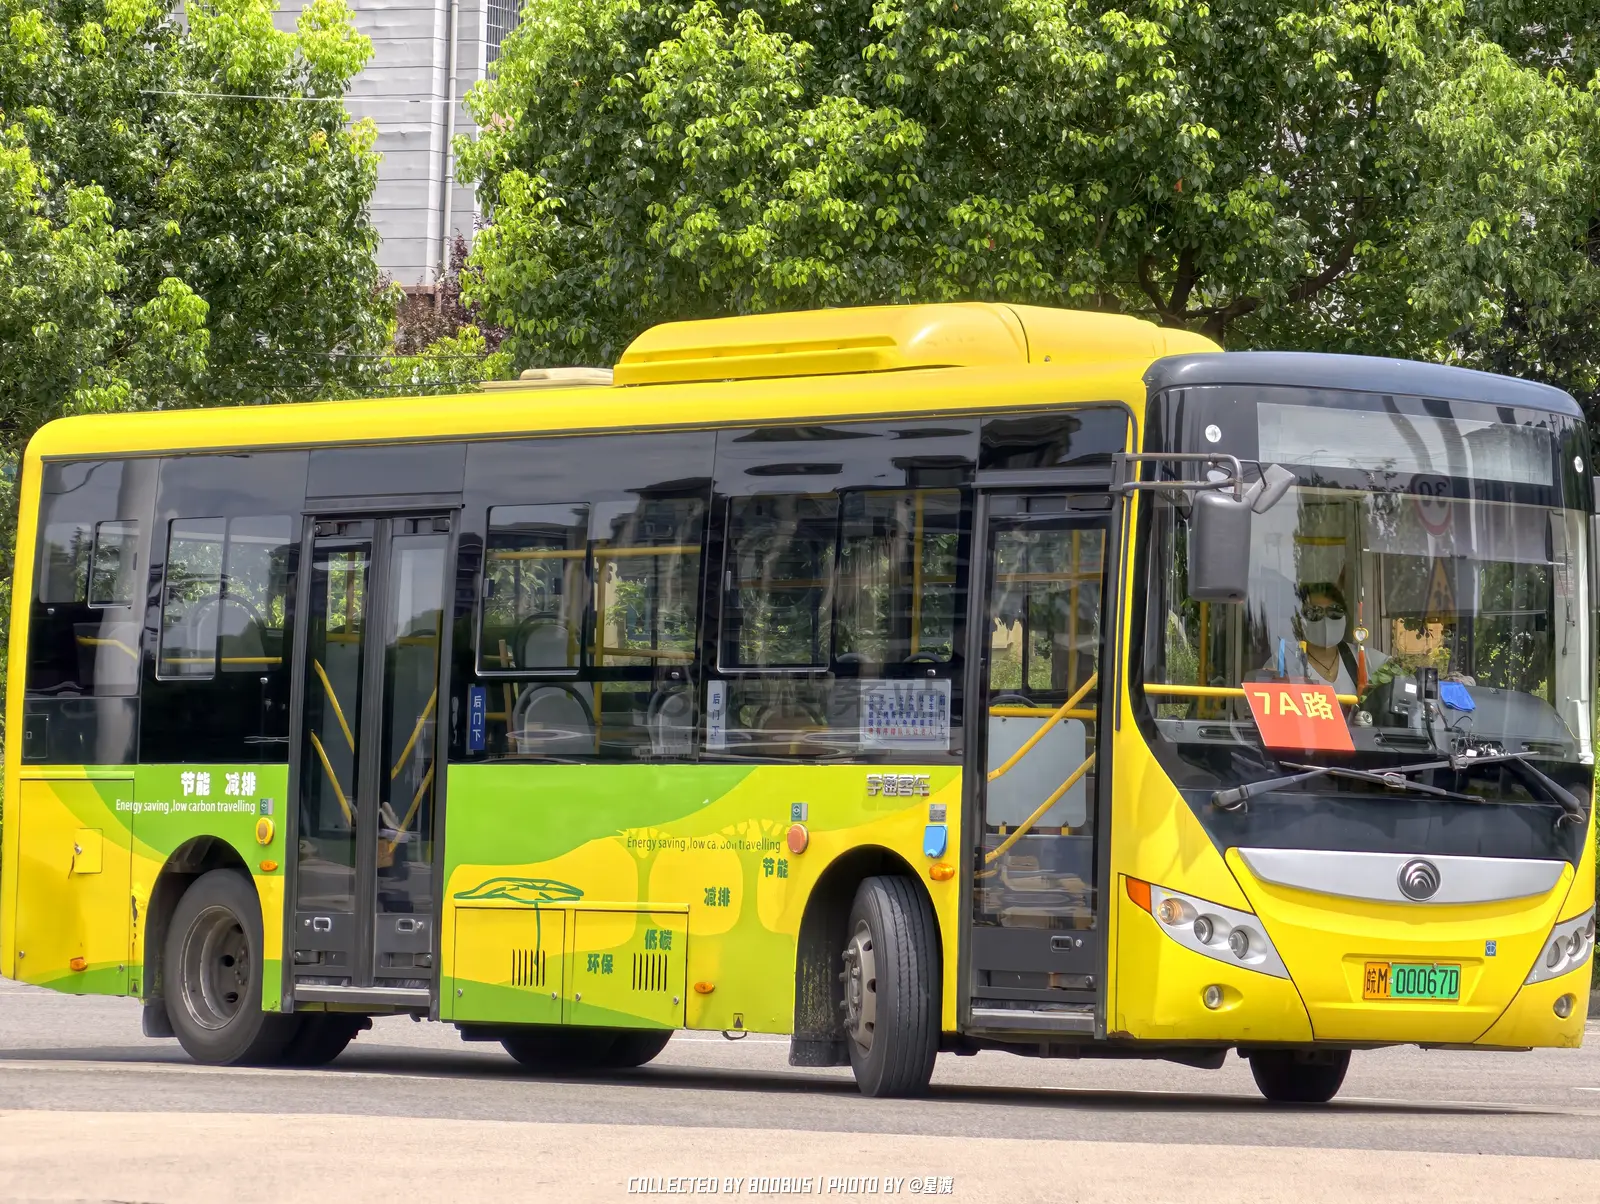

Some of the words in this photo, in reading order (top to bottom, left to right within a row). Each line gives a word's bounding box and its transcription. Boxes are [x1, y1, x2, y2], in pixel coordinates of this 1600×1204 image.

[712, 693, 721, 737] 后门下
[1254, 691, 1334, 720] 7A路
[472, 695, 482, 742] 后门下
[181, 771, 211, 796] 节能
[225, 771, 256, 797] 减排
[866, 773, 930, 797] 宇通客车
[116, 799, 142, 814] Energy
[143, 800, 170, 815] saving
[188, 800, 216, 813] carbon
[217, 799, 256, 815] travelling
[627, 836, 657, 851] Energy
[658, 837, 686, 852] saving
[763, 857, 789, 879] 节能
[704, 886, 731, 907] 减排
[644, 928, 672, 951] 低碳
[587, 953, 614, 975] 环保
